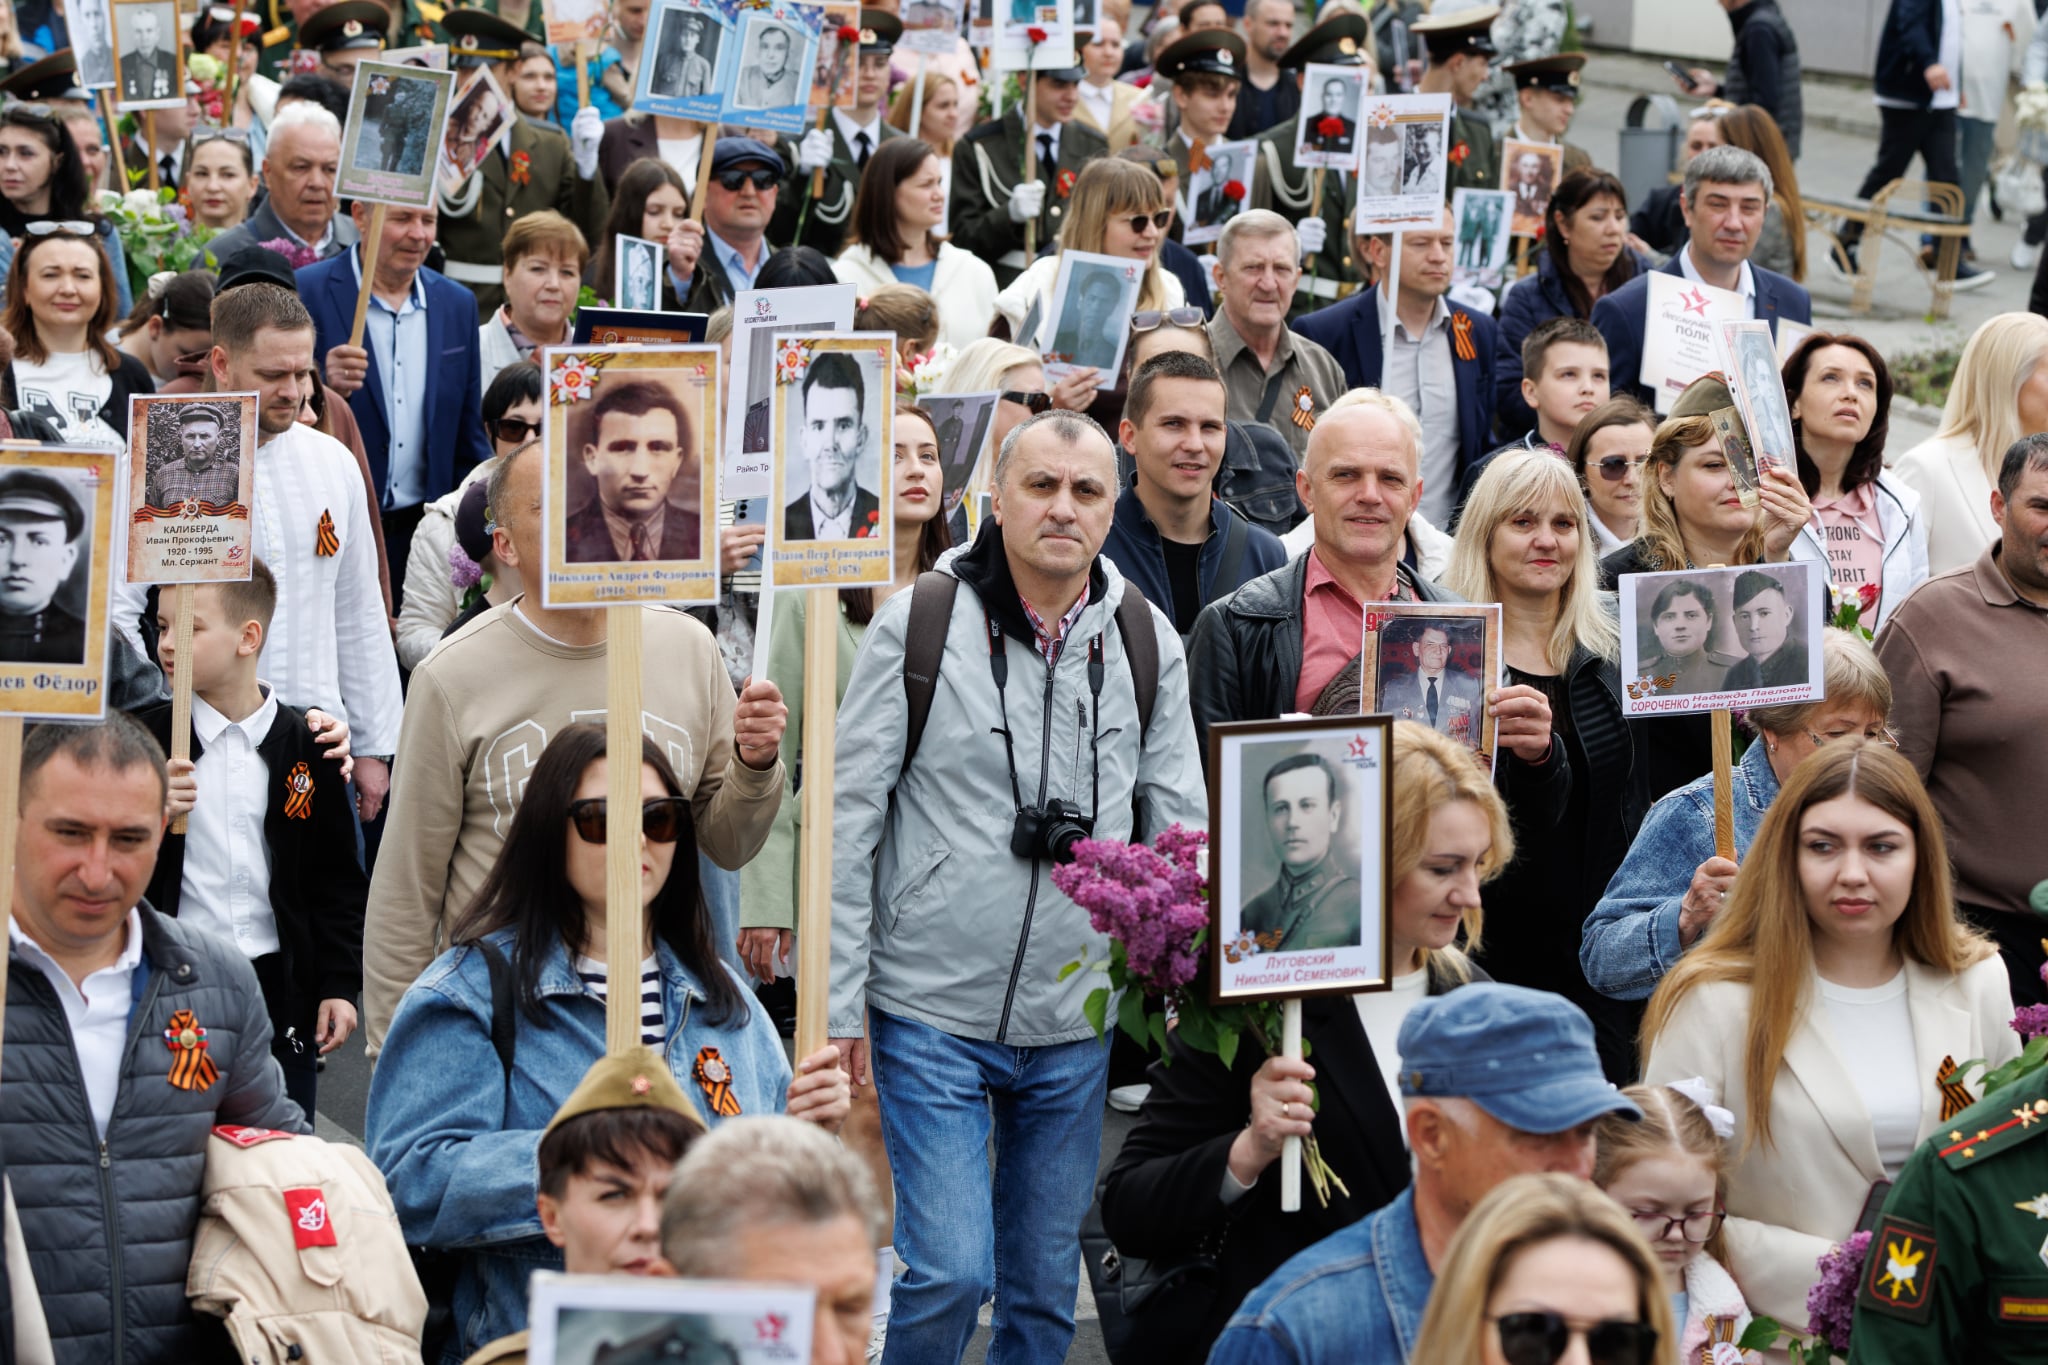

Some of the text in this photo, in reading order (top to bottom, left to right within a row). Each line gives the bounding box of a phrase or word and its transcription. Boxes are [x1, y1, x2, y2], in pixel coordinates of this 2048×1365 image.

[1675, 324, 1710, 343] ПОЛК
[736, 464, 769, 473] Райко Тр
[163, 525, 219, 534] КАЛИБЕРДА
[172, 535, 234, 545] Прокофьевич
[194, 547, 213, 555] 1995
[1827, 549, 1852, 561] STAY
[161, 558, 218, 567] Мл. Сержант
[608, 571, 649, 584] Андрей
[1366, 612, 1377, 631] 9
[33, 674, 97, 695] Фёдор
[1631, 685, 1812, 712] СОРОЧЕНКО Надежда Павловна
[1727, 694, 1810, 708] Дмитриевич
